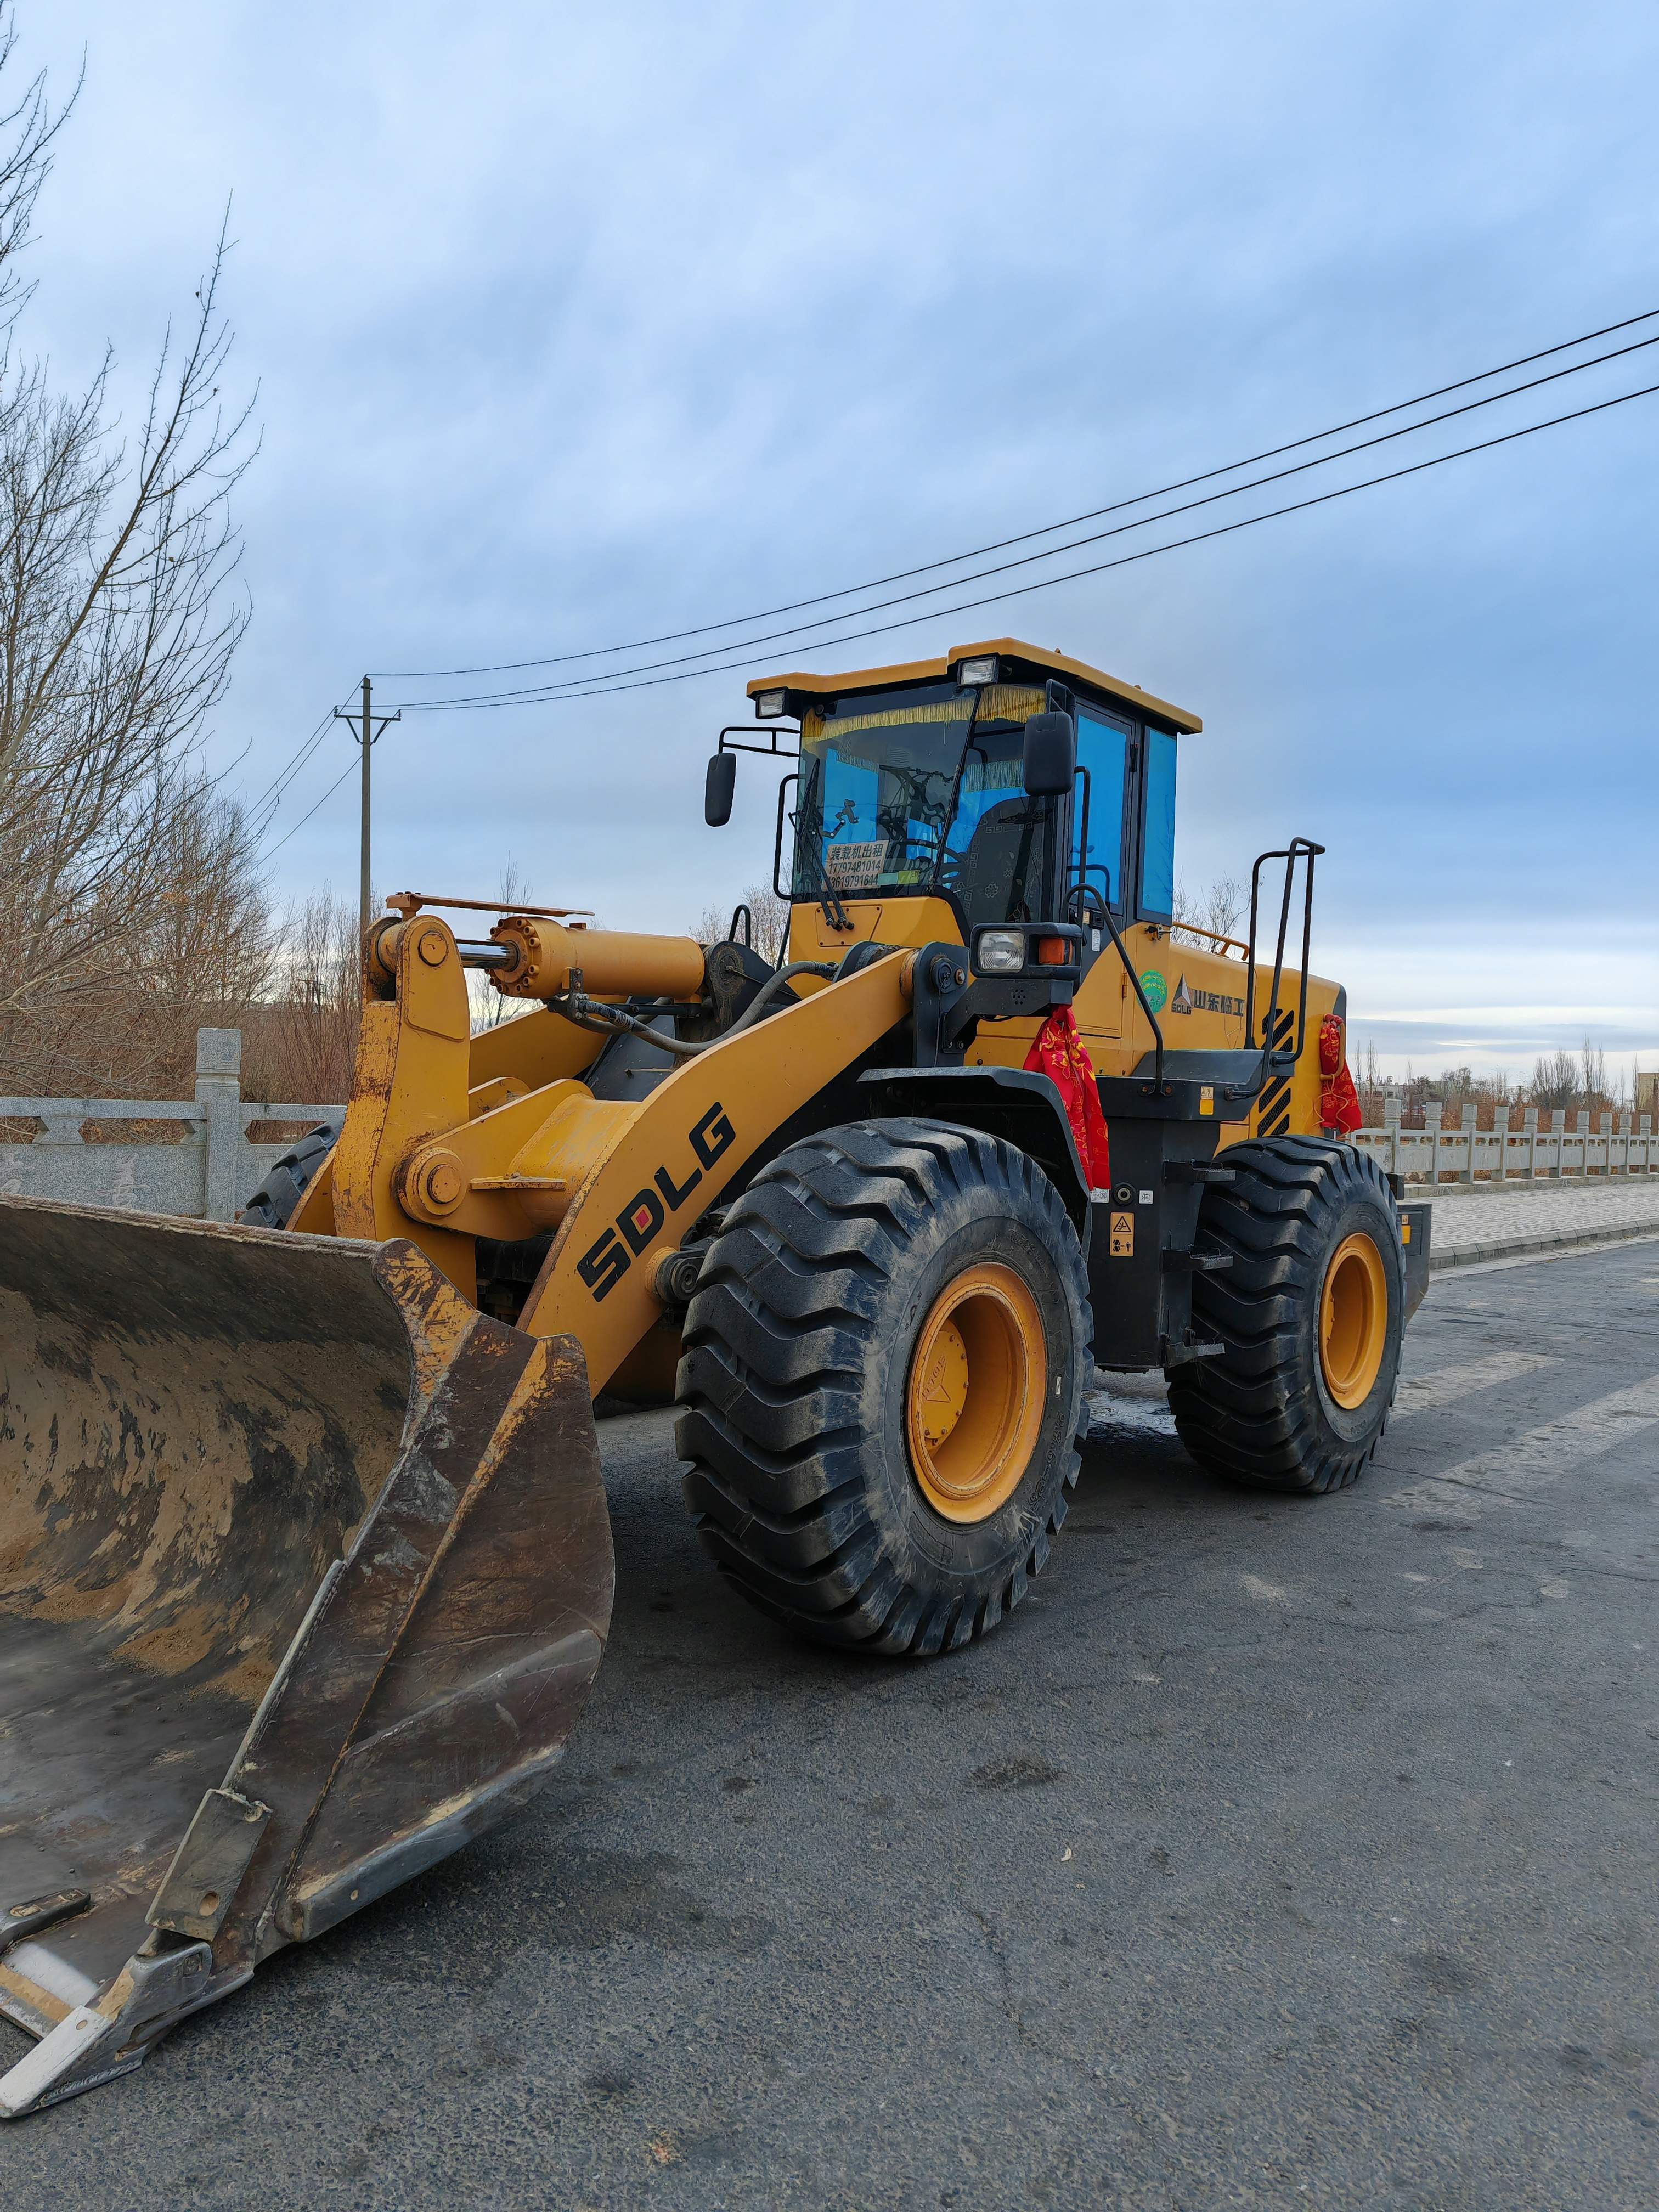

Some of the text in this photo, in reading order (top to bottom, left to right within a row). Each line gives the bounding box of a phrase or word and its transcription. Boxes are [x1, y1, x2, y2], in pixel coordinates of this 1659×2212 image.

[831, 844, 883, 860] 装载机出租
[829, 860, 881, 874] 17797481014
[1171, 1003, 1192, 1015] SDLG
[1194, 989, 1245, 1017] 山东临工
[577, 1102, 736, 1302] SDLG
